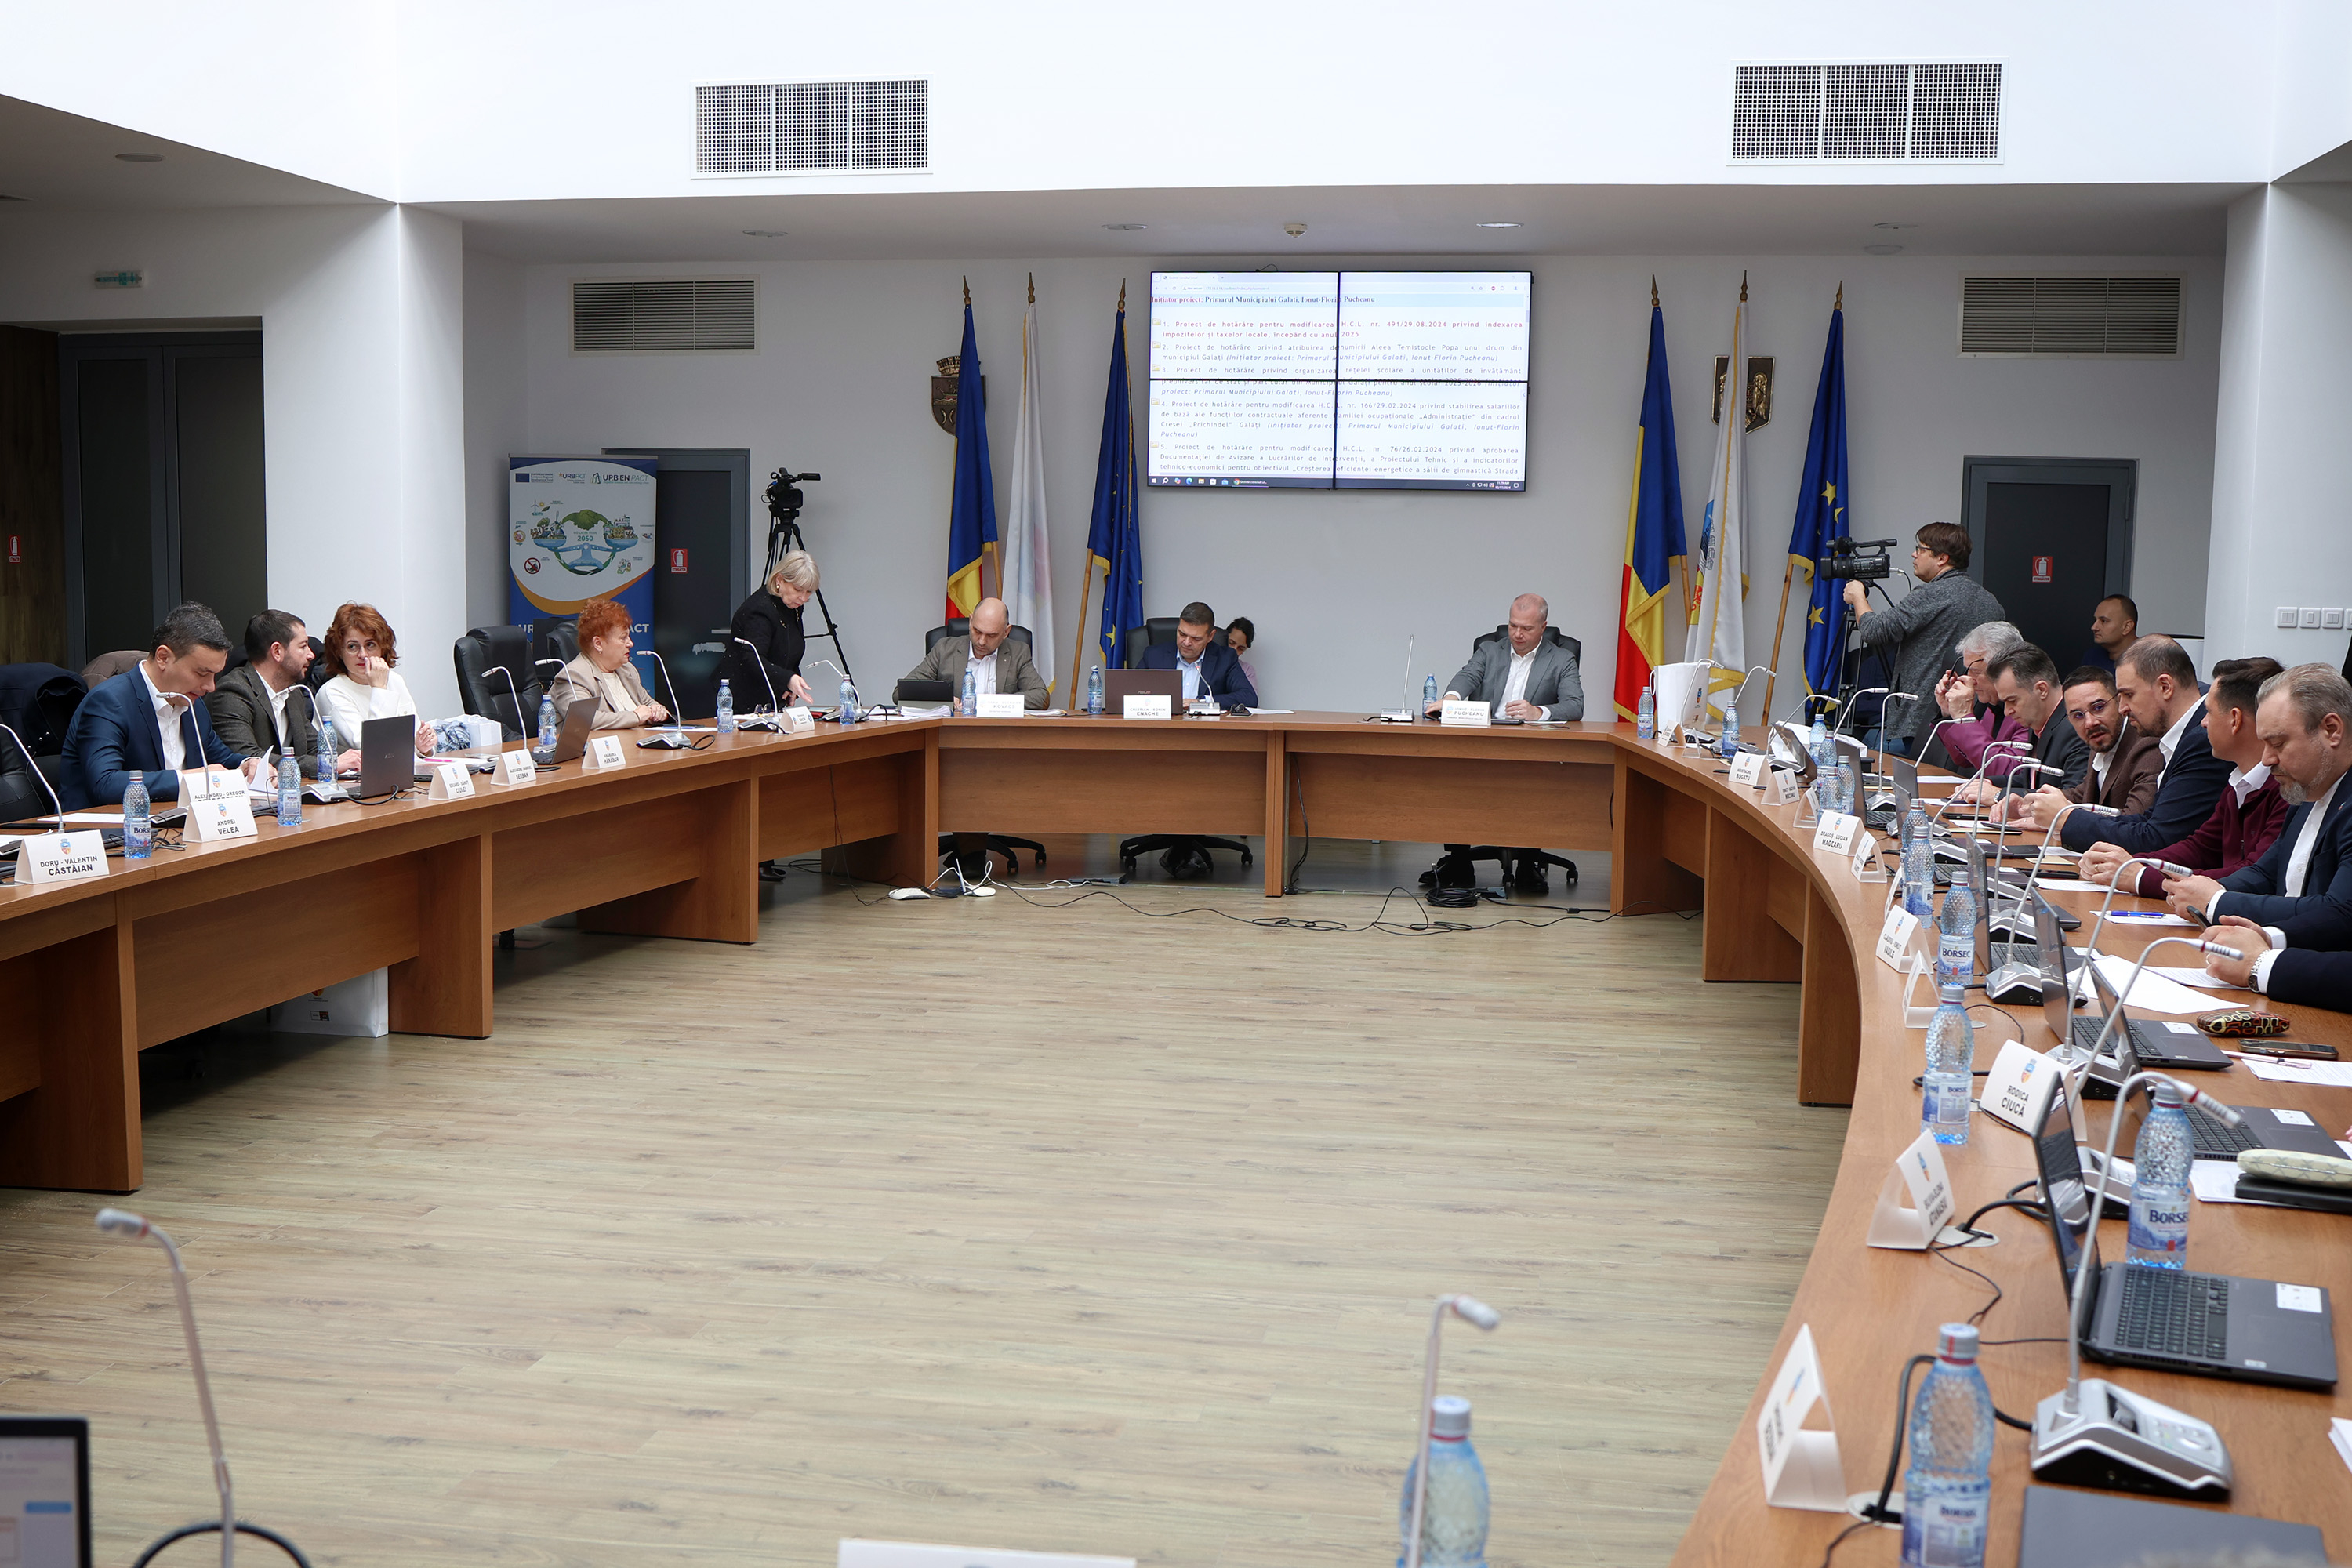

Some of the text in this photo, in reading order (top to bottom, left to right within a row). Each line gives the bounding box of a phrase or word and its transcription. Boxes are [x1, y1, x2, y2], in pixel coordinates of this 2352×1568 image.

[518, 624, 534, 633] UR
[629, 623, 649, 633] ACT
[217, 826, 240, 835] VELEA
[1835, 833, 1849, 842] LUCIAN
[1821, 838, 1843, 850] MAGEARU
[64, 855, 98, 865] VALENTIN
[48, 864, 93, 877] CĂSTĂIAN
[1942, 947, 1971, 958] BORSEC
[2006, 1084, 2029, 1102] RODICA
[2001, 1095, 2026, 1118] CIUCĂ
